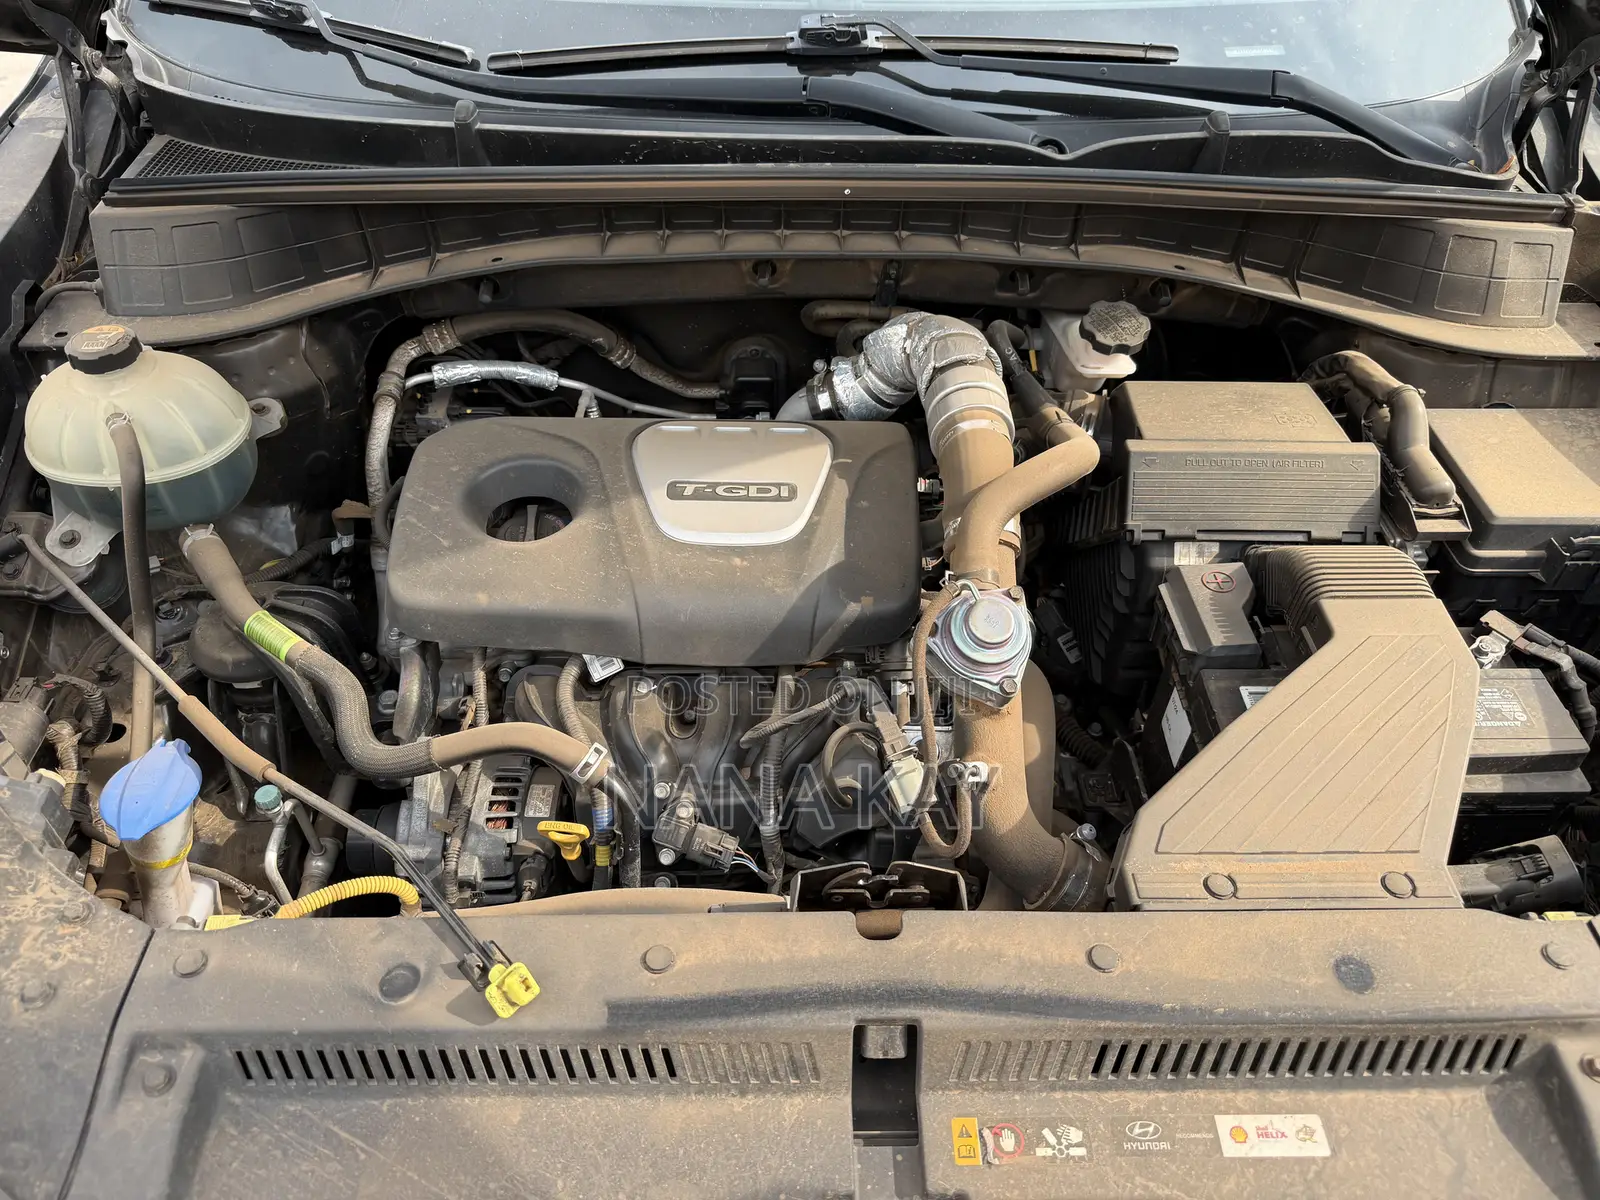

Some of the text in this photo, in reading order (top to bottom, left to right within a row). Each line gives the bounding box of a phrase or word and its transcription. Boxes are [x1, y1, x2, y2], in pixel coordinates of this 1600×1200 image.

[1185, 458, 1209, 467] PULL
[1210, 458, 1229, 467] OUT
[1230, 458, 1242, 467] TO
[1244, 458, 1269, 468] OPEN
[675, 483, 789, 498] T-GDI
[544, 822, 561, 830] ENG
[1123, 1141, 1171, 1150] HYUNDAI
[1257, 1131, 1288, 1140] HELIX
